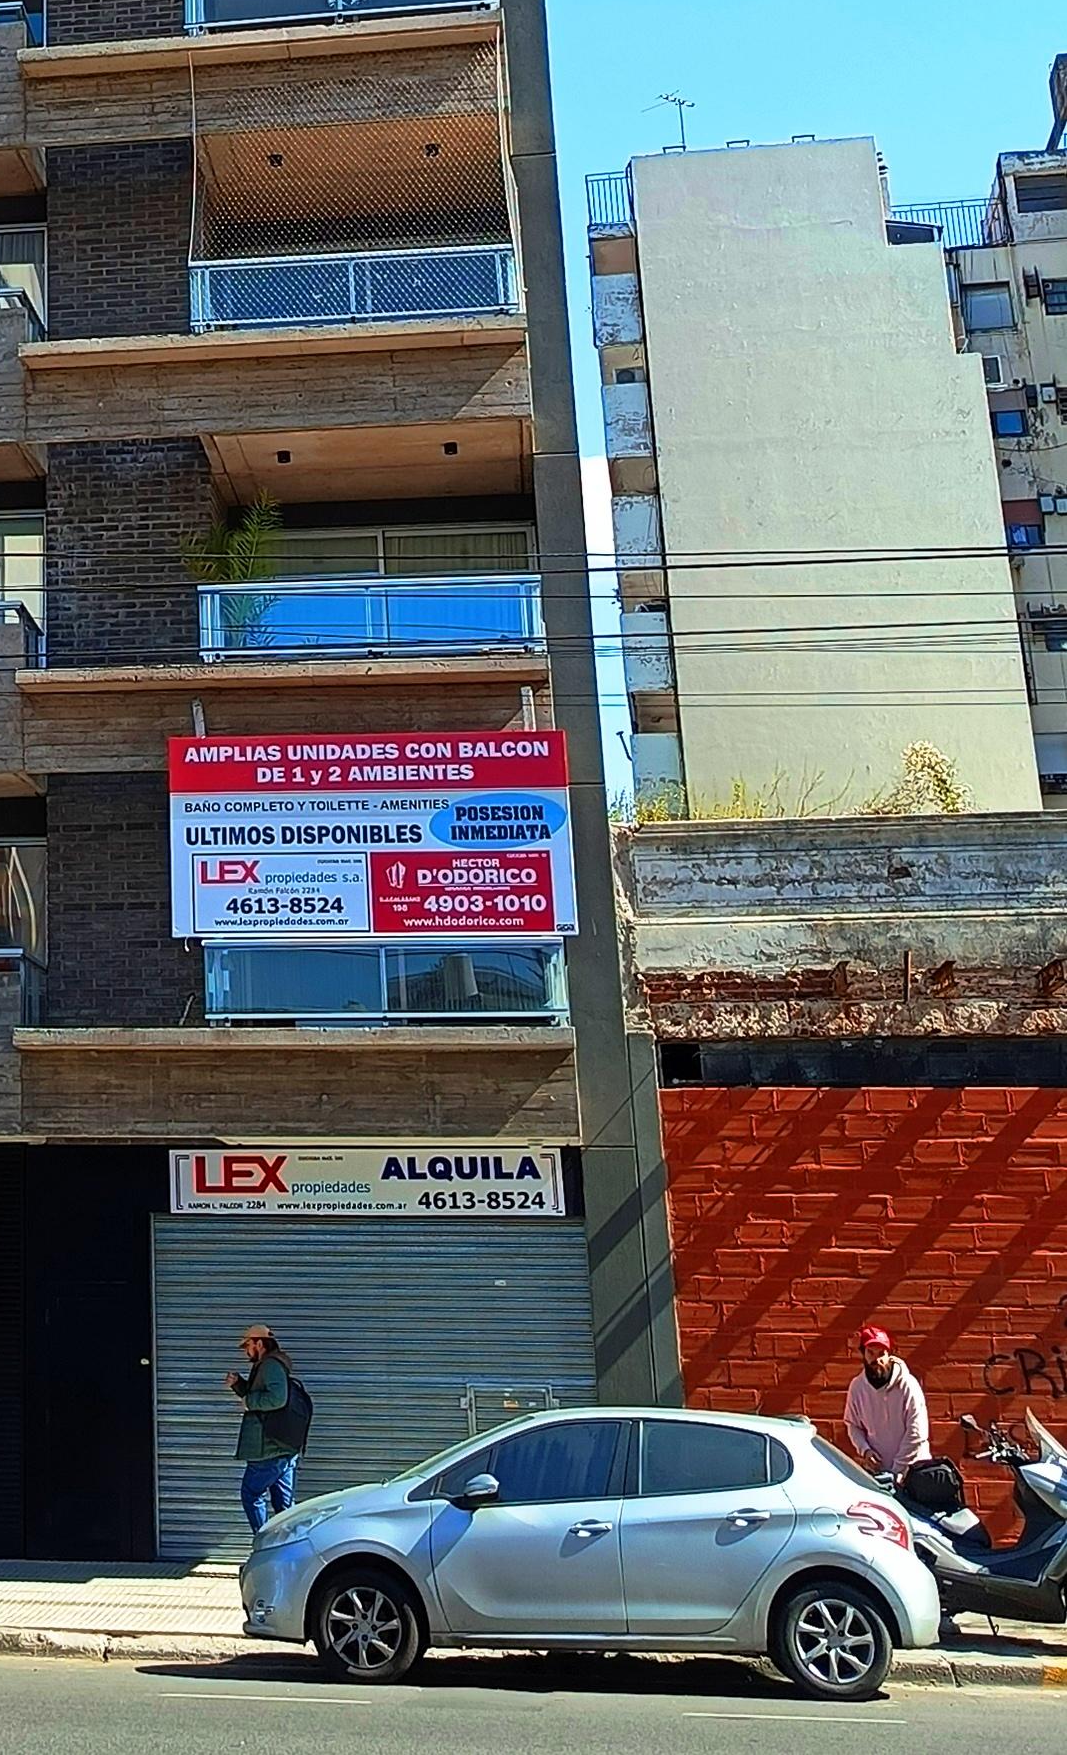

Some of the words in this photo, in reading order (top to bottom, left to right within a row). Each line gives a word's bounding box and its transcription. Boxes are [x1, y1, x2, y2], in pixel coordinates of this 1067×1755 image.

[184, 746, 282, 762] AMPLIAS
[287, 743, 400, 761] UNIDADES
[405, 742, 452, 759] CON
[459, 740, 549, 758] BALCON
[257, 767, 286, 783] DE
[292, 766, 305, 782] 1
[310, 770, 322, 785] y
[328, 766, 342, 782] 2
[348, 764, 475, 781] AMBIENTES
[184, 800, 221, 813] BAÑO
[224, 800, 294, 812] COMPLETO
[297, 800, 307, 811] Y
[309, 799, 370, 811] TOILETTE
[380, 799, 450, 810] AMENITIES
[455, 805, 544, 821] POSESION
[185, 826, 276, 845] ULTIMOS
[281, 823, 423, 844] DISPONIBLES
[450, 823, 552, 841] INMEDIATA
[452, 858, 500, 868] HECTOR
[200, 860, 260, 884] LEX
[265, 871, 337, 885] propiedades
[342, 873, 364, 883] s.a.
[417, 868, 538, 884] D'ODORICO
[225, 897, 344, 914] 4613-8524
[423, 895, 547, 912] 4903-1010
[214, 917, 350, 927] www.lexpropiedades.com.ar
[403, 915, 525, 926] www.hdodorico.com
[195, 1156, 290, 1194] LEX
[291, 1180, 371, 1195] propiedades
[380, 1156, 542, 1182] ALQUILA
[246, 1200, 267, 1209] 2284
[277, 1201, 407, 1210] www.lexpropiedades.com.ar
[417, 1191, 546, 1210] 4613-8524
